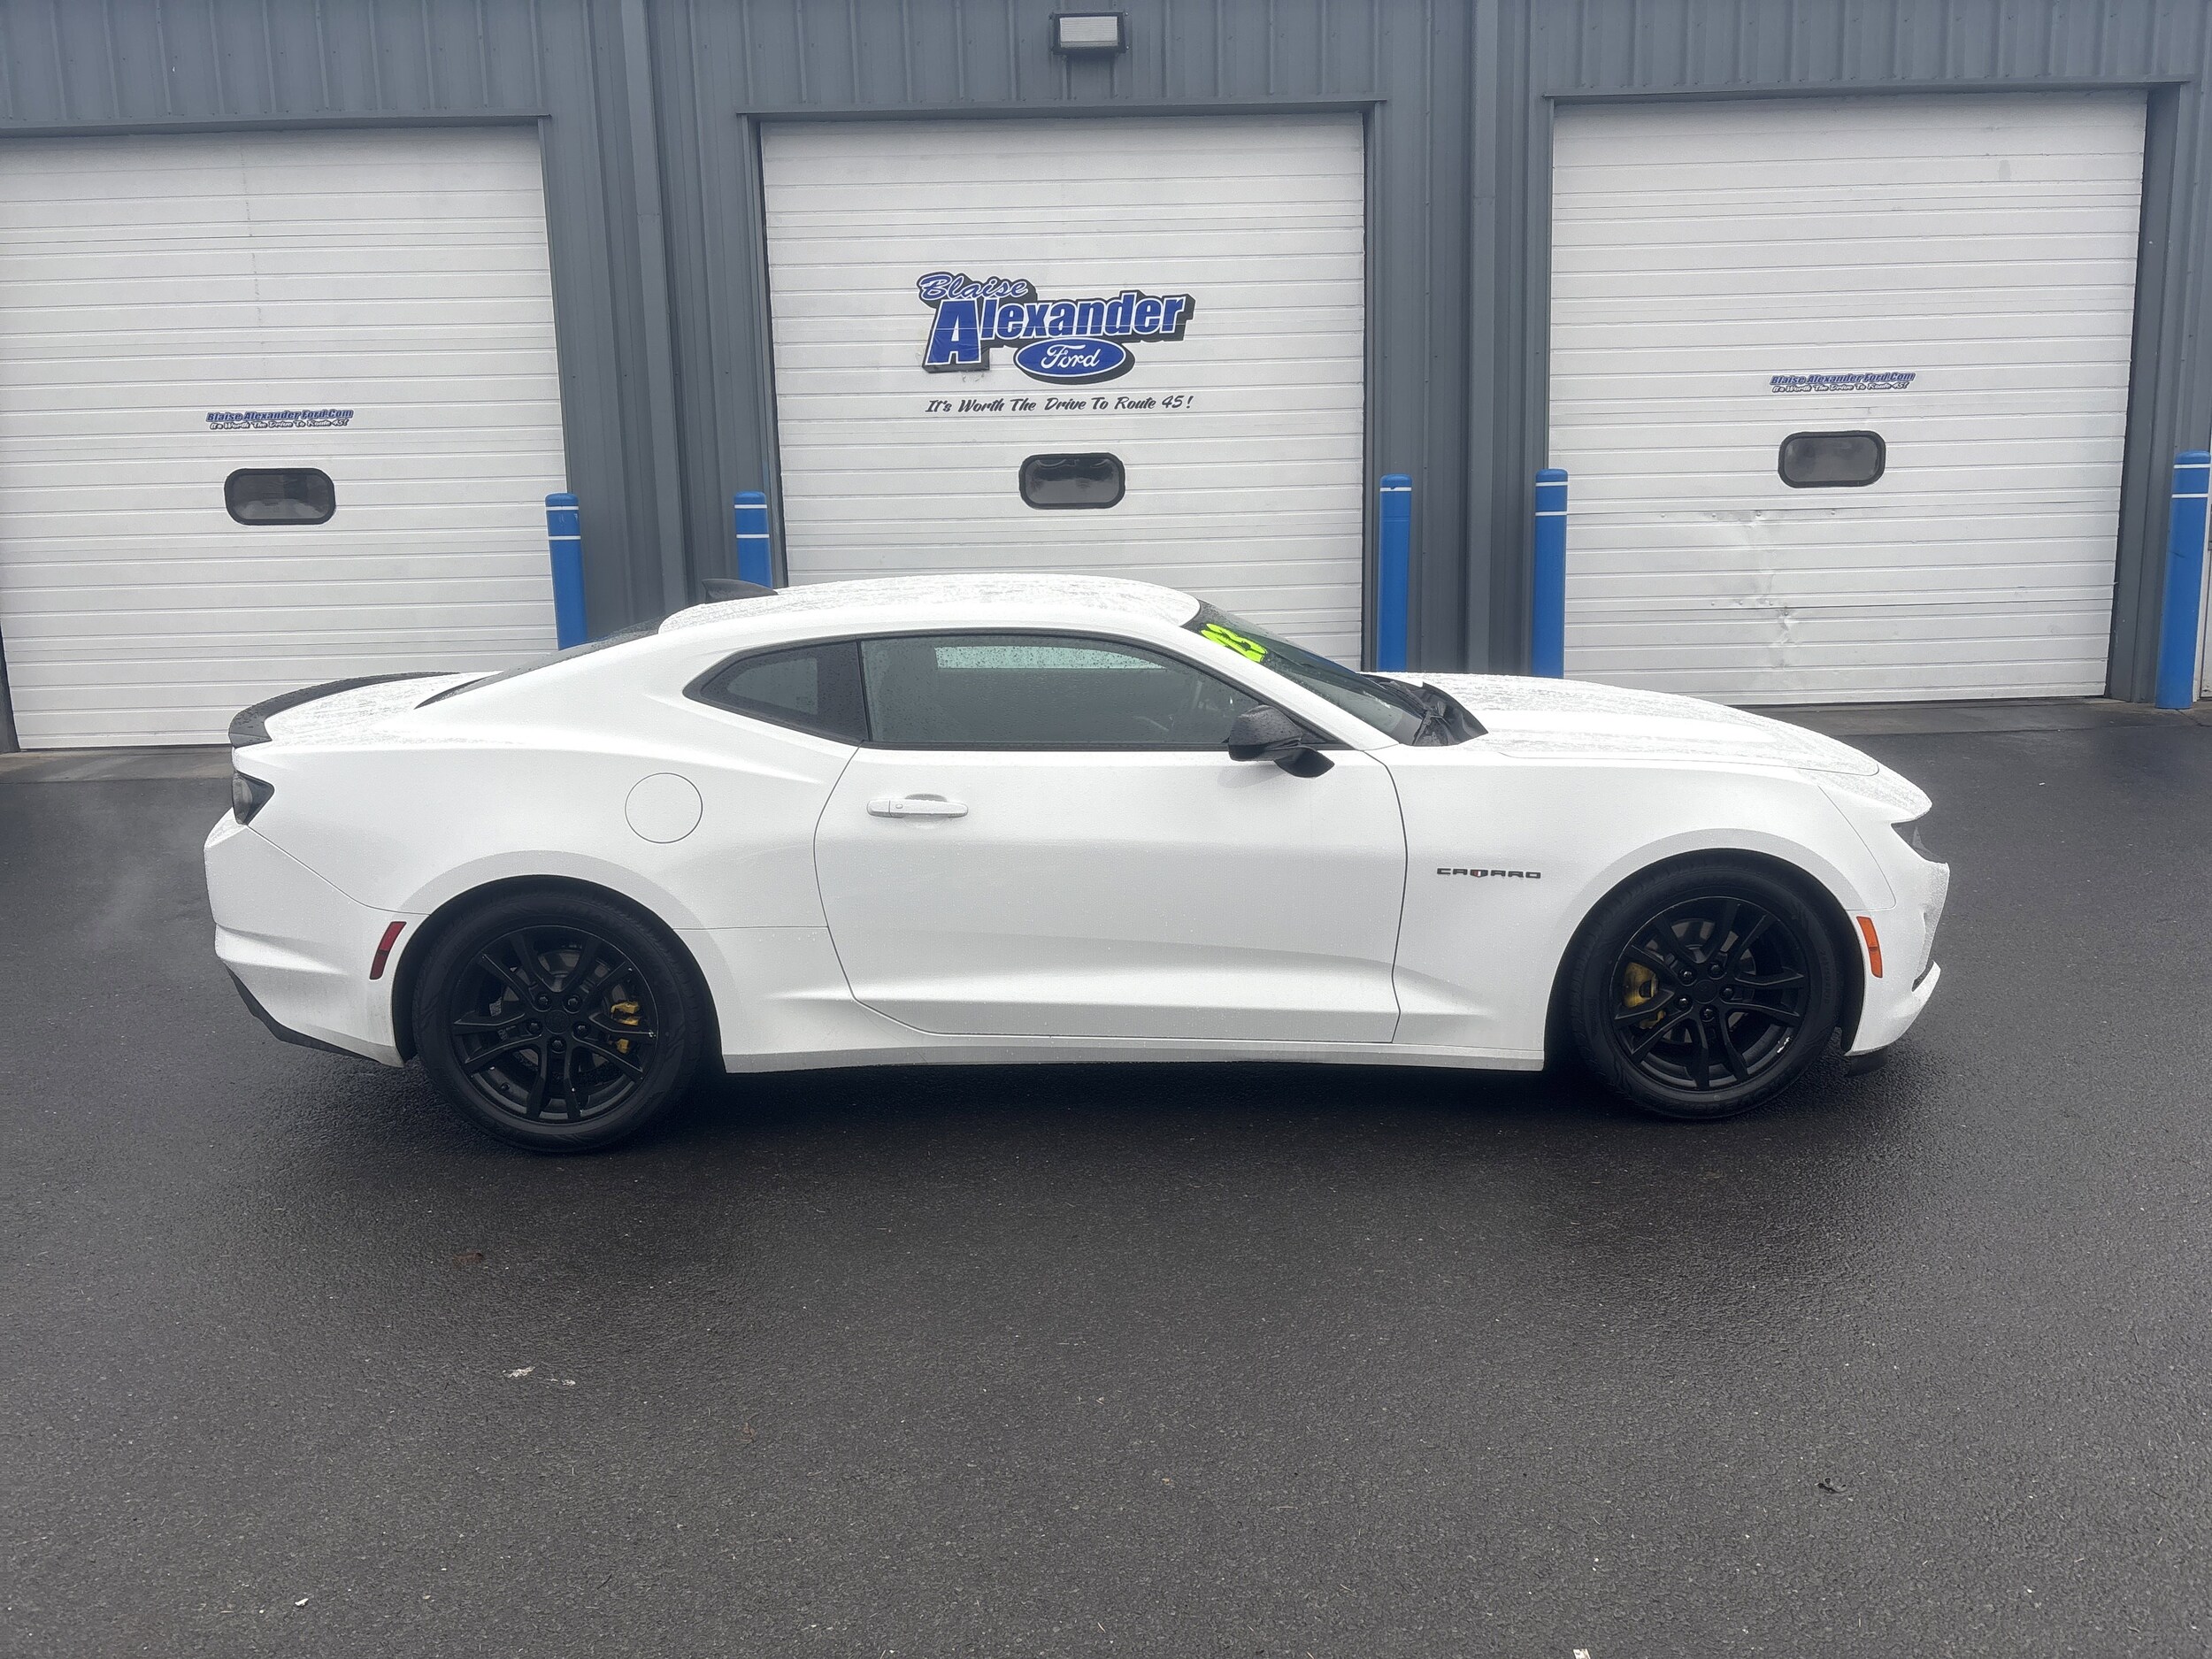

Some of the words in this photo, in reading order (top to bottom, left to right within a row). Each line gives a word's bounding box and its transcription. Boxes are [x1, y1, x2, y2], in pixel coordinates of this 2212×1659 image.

[918, 273, 1030, 301] Blaise
[924, 290, 1188, 366] Alexander
[1040, 343, 1102, 370] Ford
[1770, 375, 1806, 386] Blaise
[1807, 373, 1863, 384] Alexander
[925, 399, 953, 413] It's
[957, 397, 1005, 413] Worth
[1010, 397, 1037, 411] The
[1043, 397, 1087, 411] Drive
[1091, 396, 1110, 411] To
[1113, 396, 1157, 411] Route
[1161, 395, 1194, 410] 45!
[206, 411, 242, 422] Blaise
[243, 411, 302, 421] Alexander
[1436, 867, 1541, 879] CAARO
